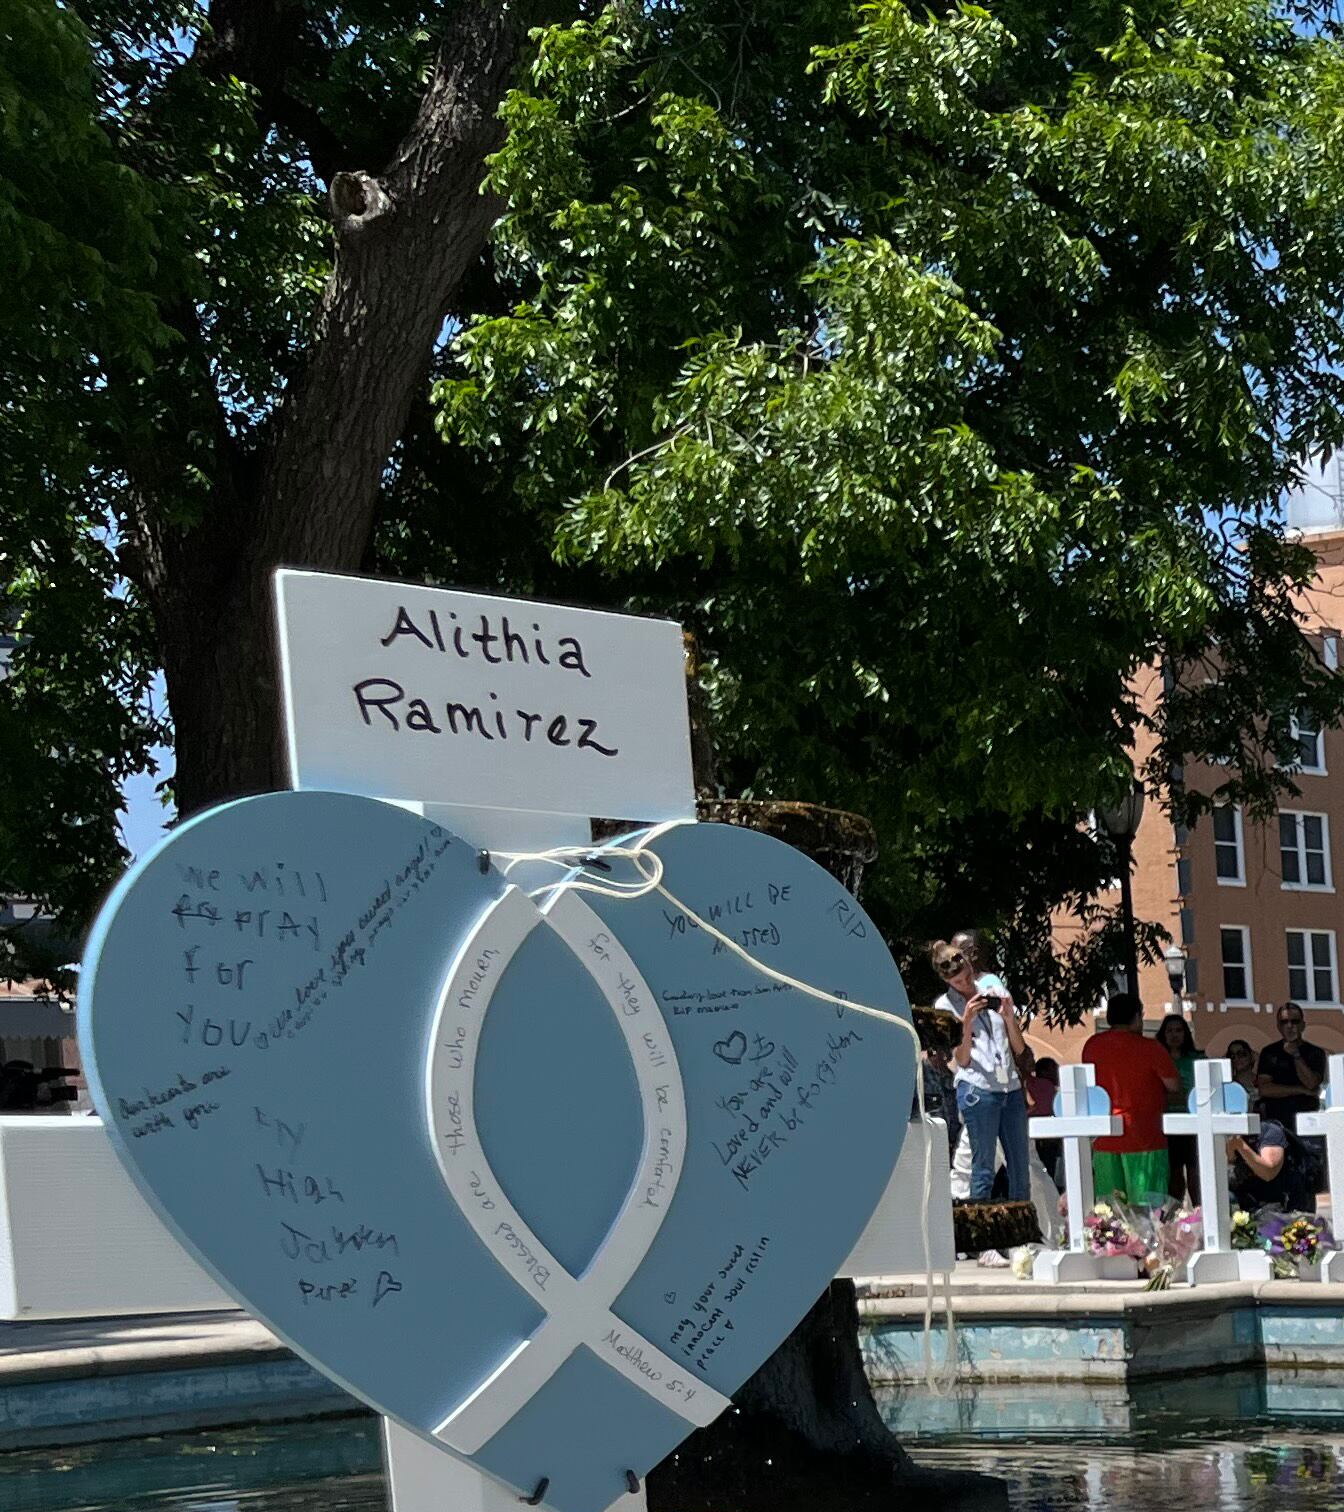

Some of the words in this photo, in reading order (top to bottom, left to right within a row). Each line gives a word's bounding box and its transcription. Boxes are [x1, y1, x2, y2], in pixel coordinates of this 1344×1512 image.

[380, 606, 592, 678] Alithia
[353, 678, 619, 757] Ramirez
[767, 883, 793, 905] BE
[831, 899, 867, 940] RIP
[586, 932, 610, 962] for
[617, 972, 641, 1016] they
[644, 1032, 665, 1067] will
[444, 1026, 466, 1070] who
[444, 1091, 466, 1155] those
[470, 1171, 495, 1210] are
[494, 1221, 551, 1291] Blessed
[693, 1280, 717, 1313] your
[601, 1328, 663, 1382] Matthew
